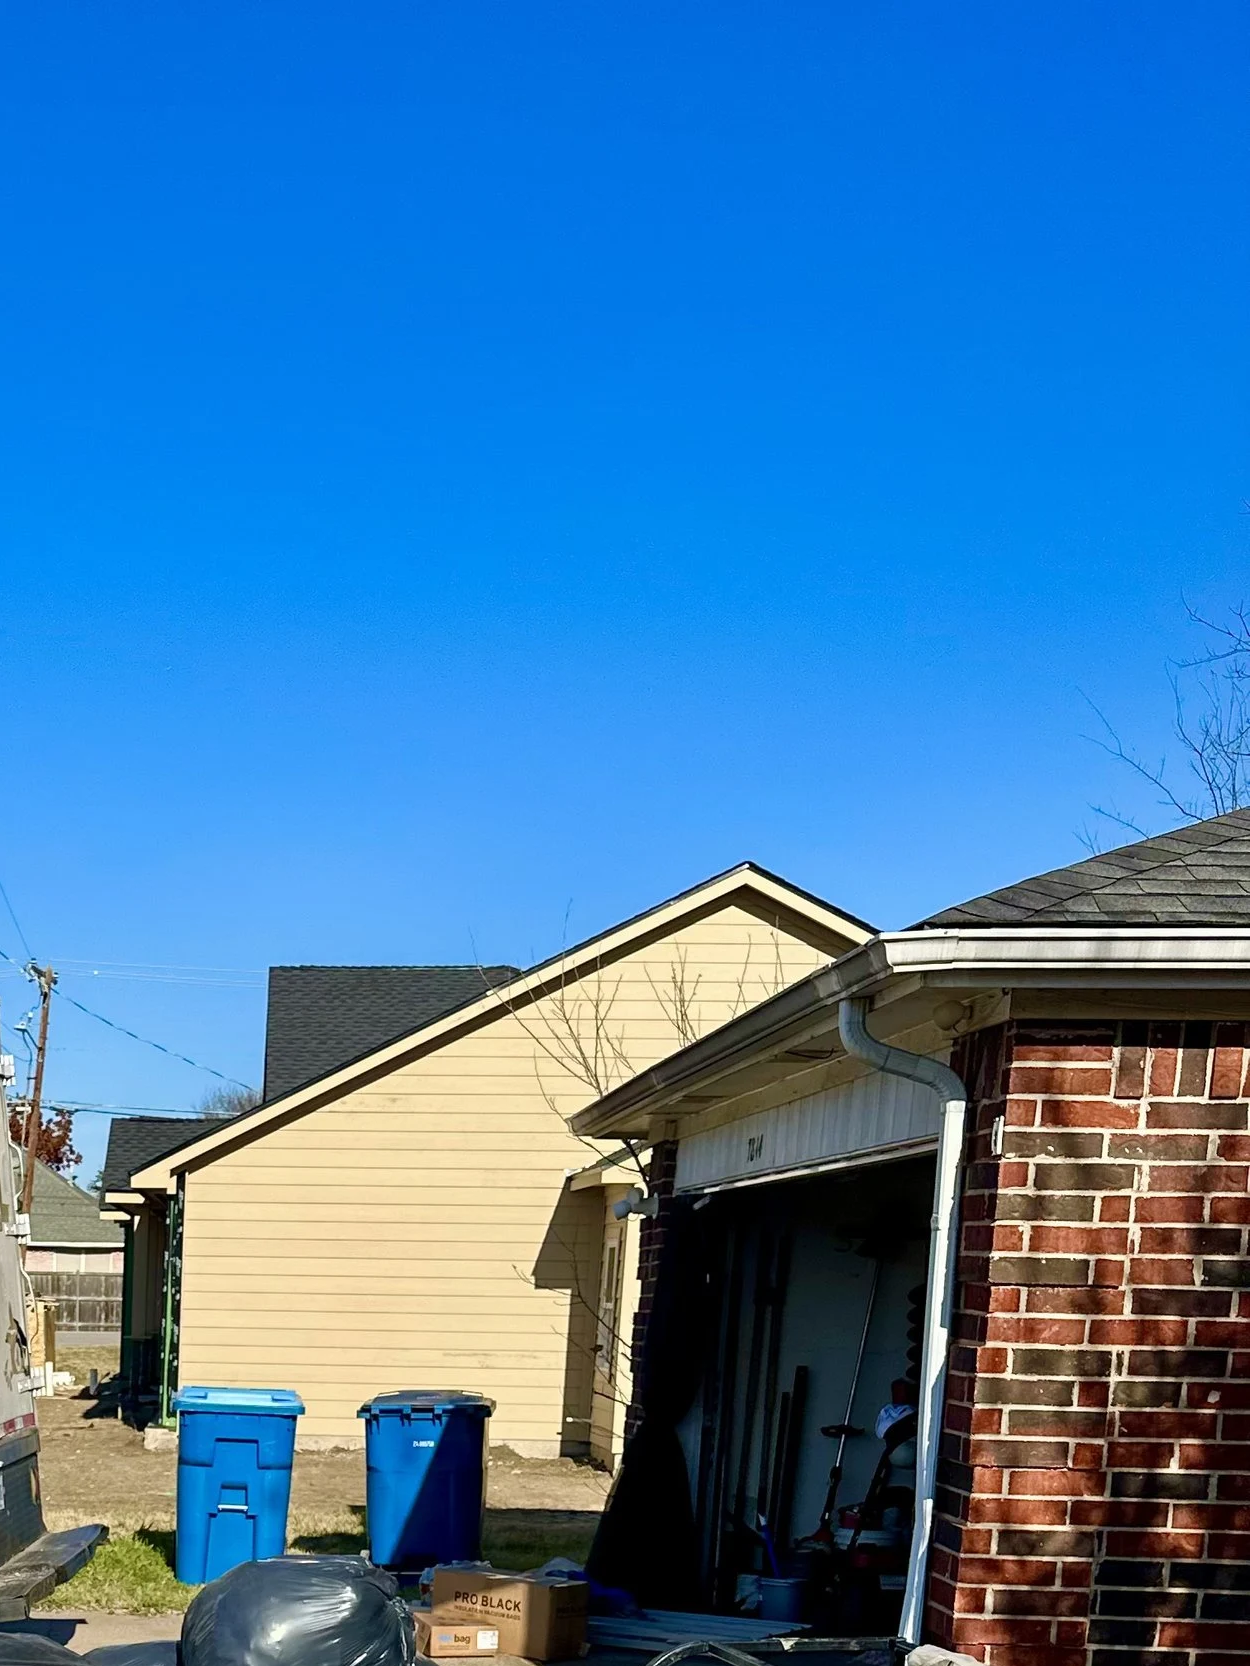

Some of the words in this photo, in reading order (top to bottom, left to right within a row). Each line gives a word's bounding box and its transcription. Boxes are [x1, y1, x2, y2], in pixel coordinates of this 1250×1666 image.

[454, 1590, 478, 1606] PRO
[481, 1595, 522, 1613] BLACK
[454, 1633, 471, 1644] bag
